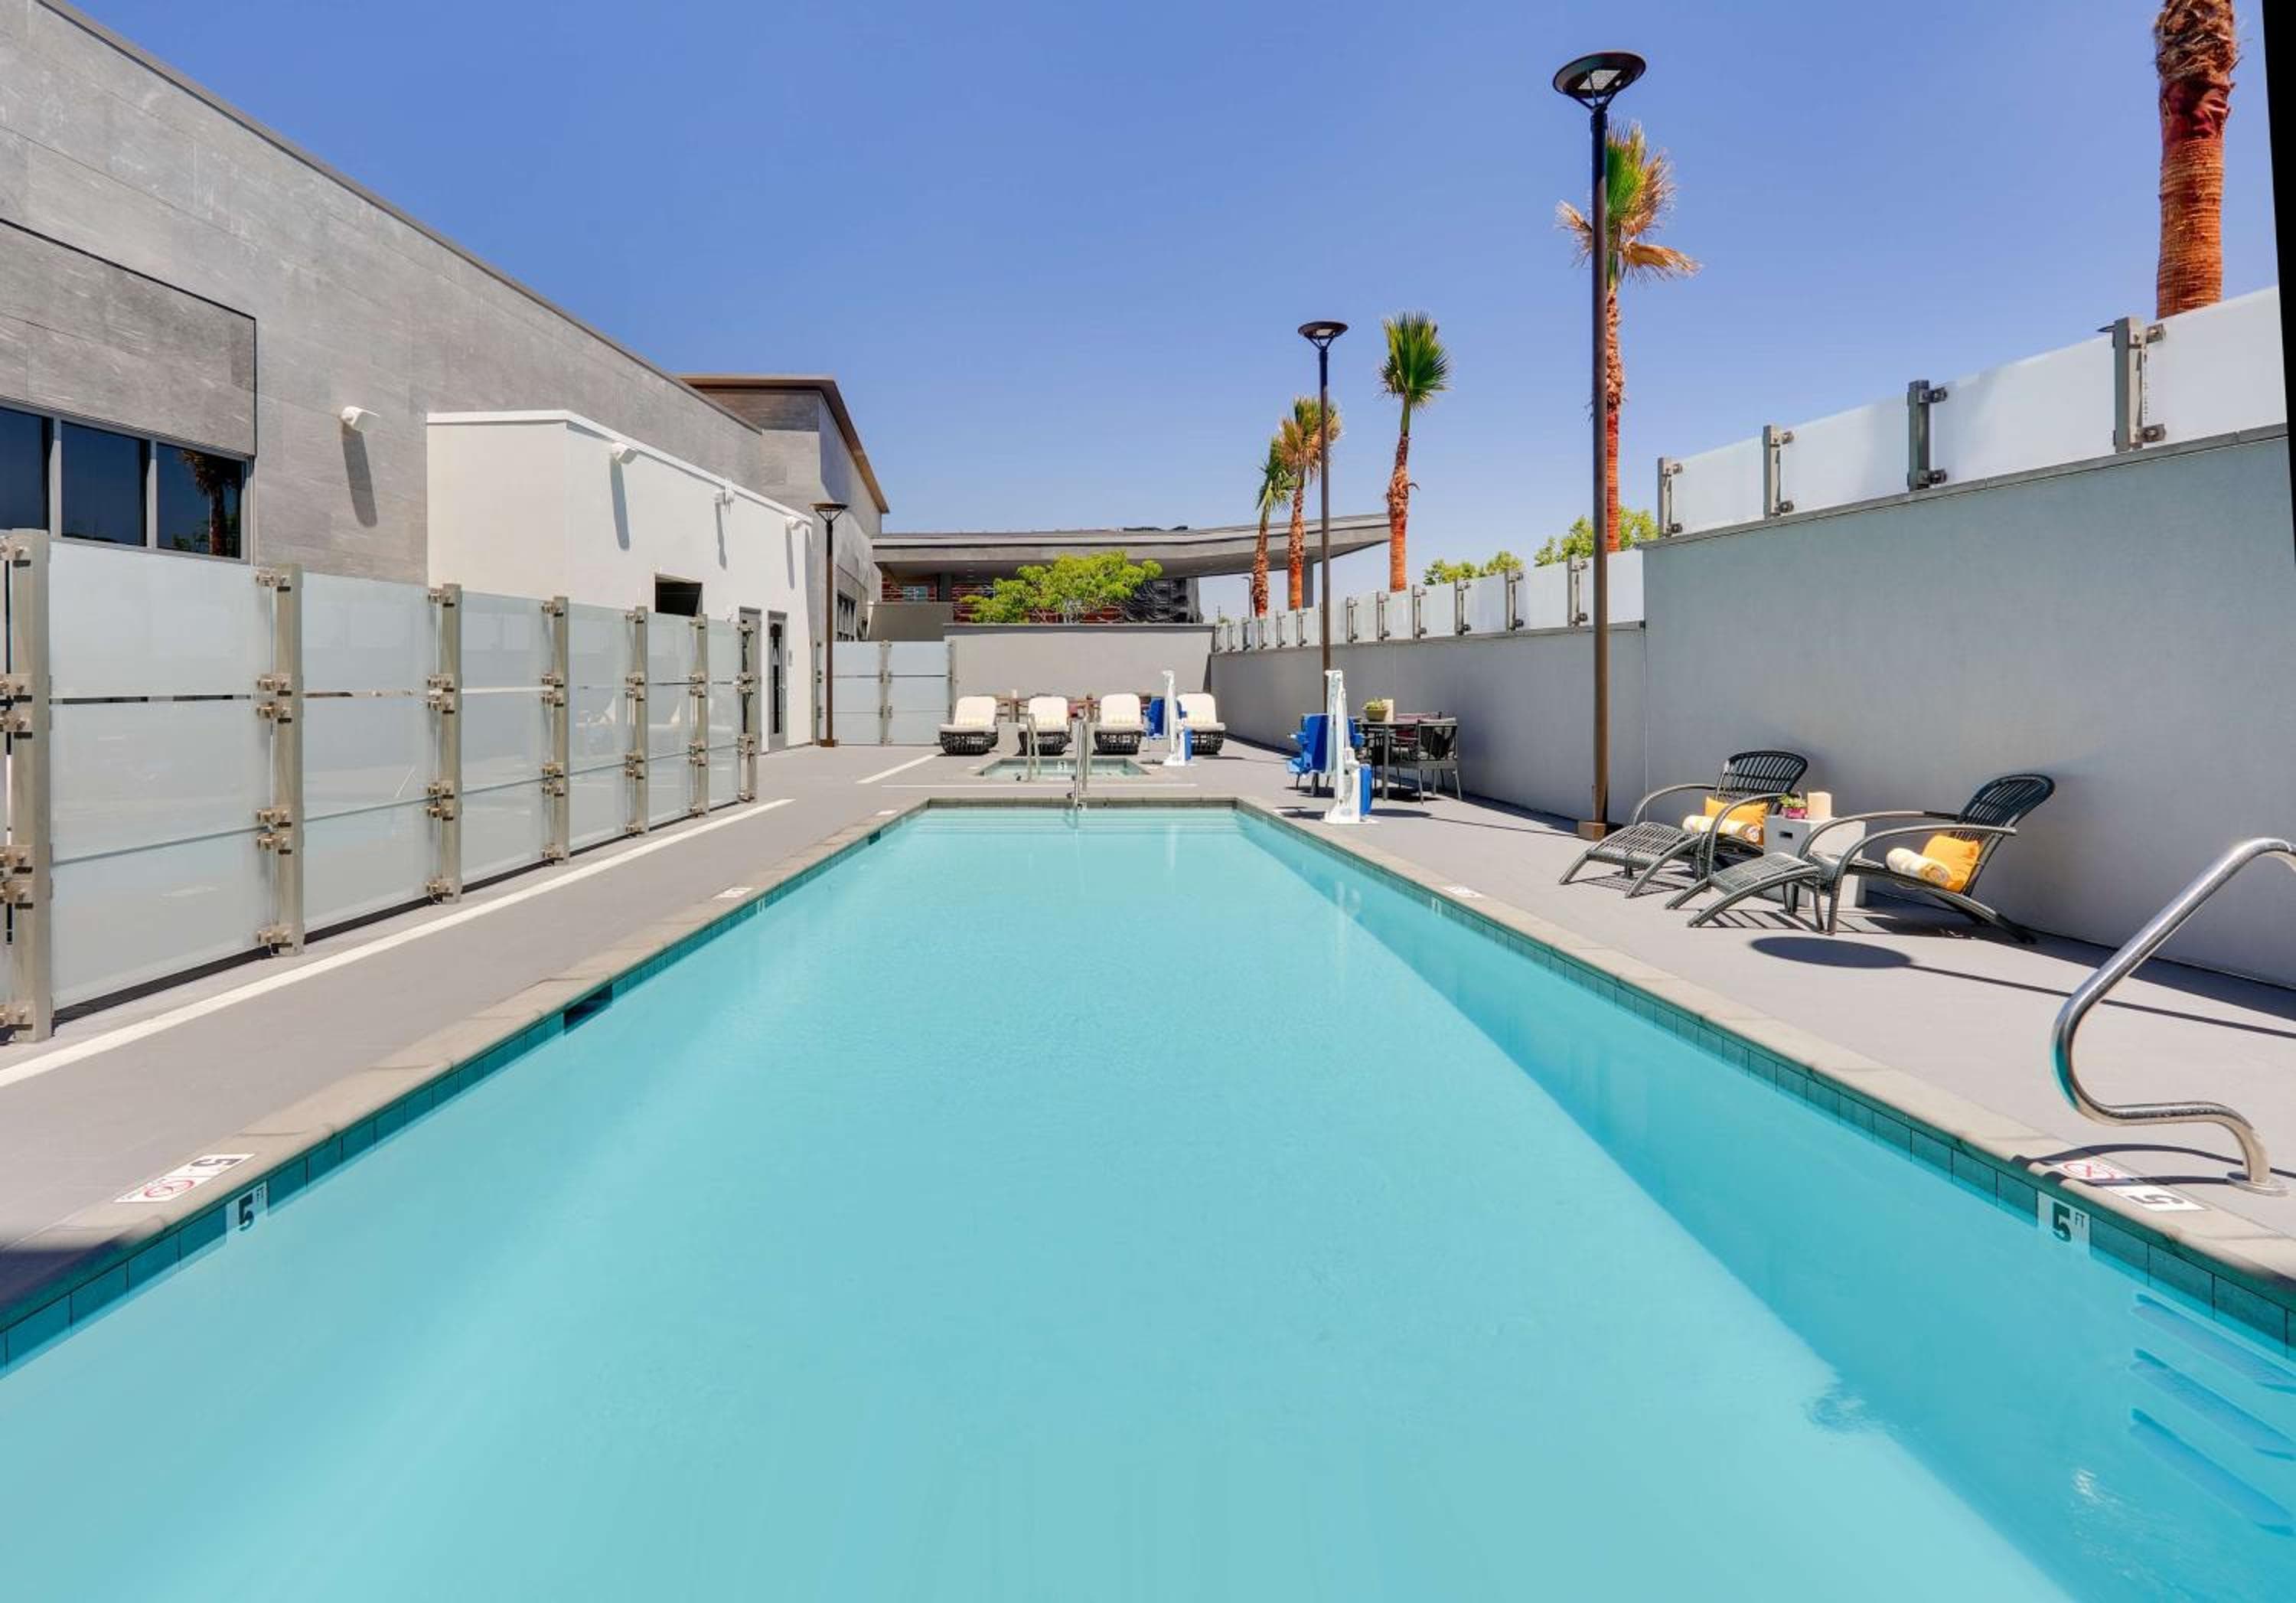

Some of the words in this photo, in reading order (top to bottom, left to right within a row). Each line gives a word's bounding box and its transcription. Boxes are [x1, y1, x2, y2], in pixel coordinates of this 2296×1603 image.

[239, 1192, 254, 1232] 5
[2053, 1202, 2072, 1242] 5
[2075, 1212, 2085, 1228] FT
